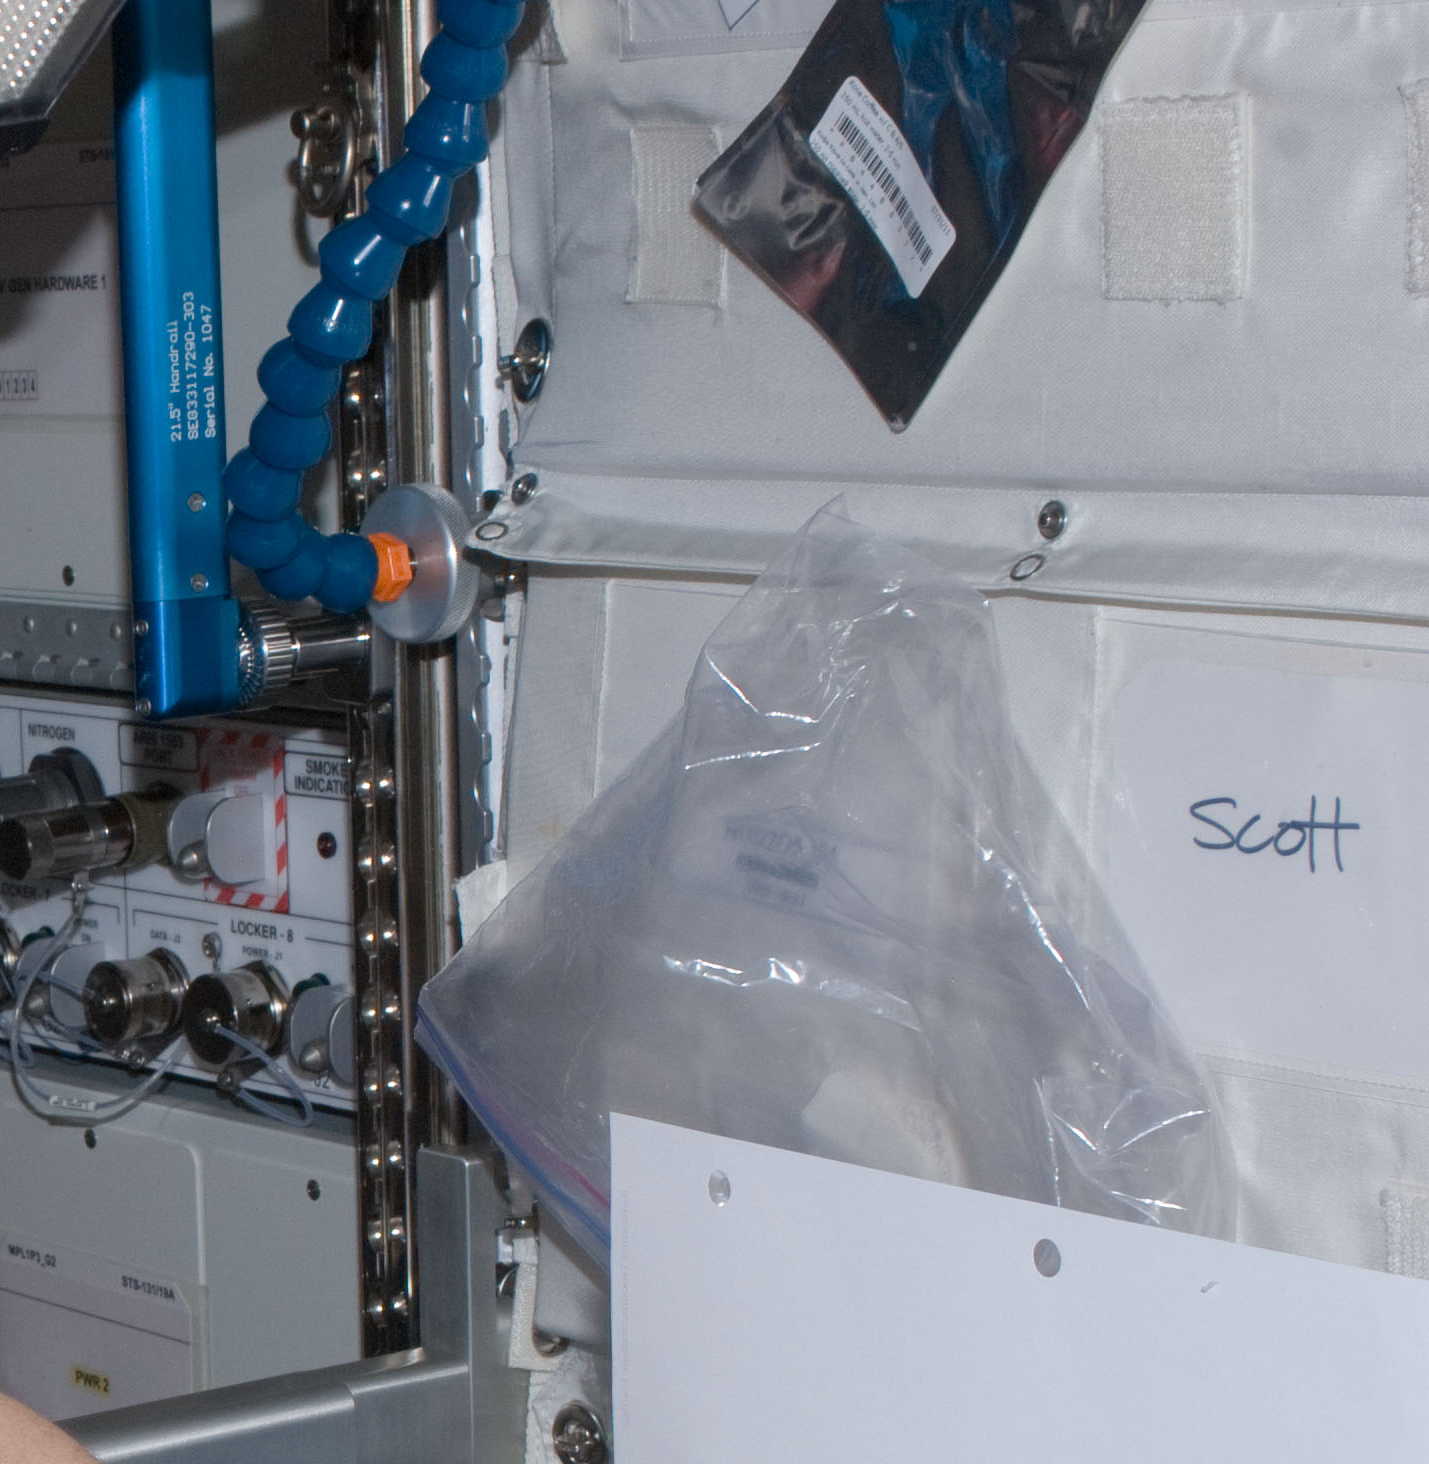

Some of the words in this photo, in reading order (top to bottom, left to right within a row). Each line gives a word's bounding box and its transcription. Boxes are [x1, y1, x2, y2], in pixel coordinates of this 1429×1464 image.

[34, 274, 99, 292] HARDWARE
[200, 304, 214, 343] 1047
[166, 320, 181, 394] Handrail
[203, 352, 215, 377] No.
[203, 385, 217, 439] Serial
[27, 722, 76, 742] NITROGEN
[305, 759, 349, 777] SMOKE
[1189, 794, 1361, 874] Scott
[149, 928, 167, 942] DATA
[230, 919, 278, 940] LOCKER
[242, 945, 270, 959] POWER
[121, 1275, 176, 1301] STS-131/19A
[75, 1369, 102, 1391] PWR
[102, 1377, 110, 1393] 2
